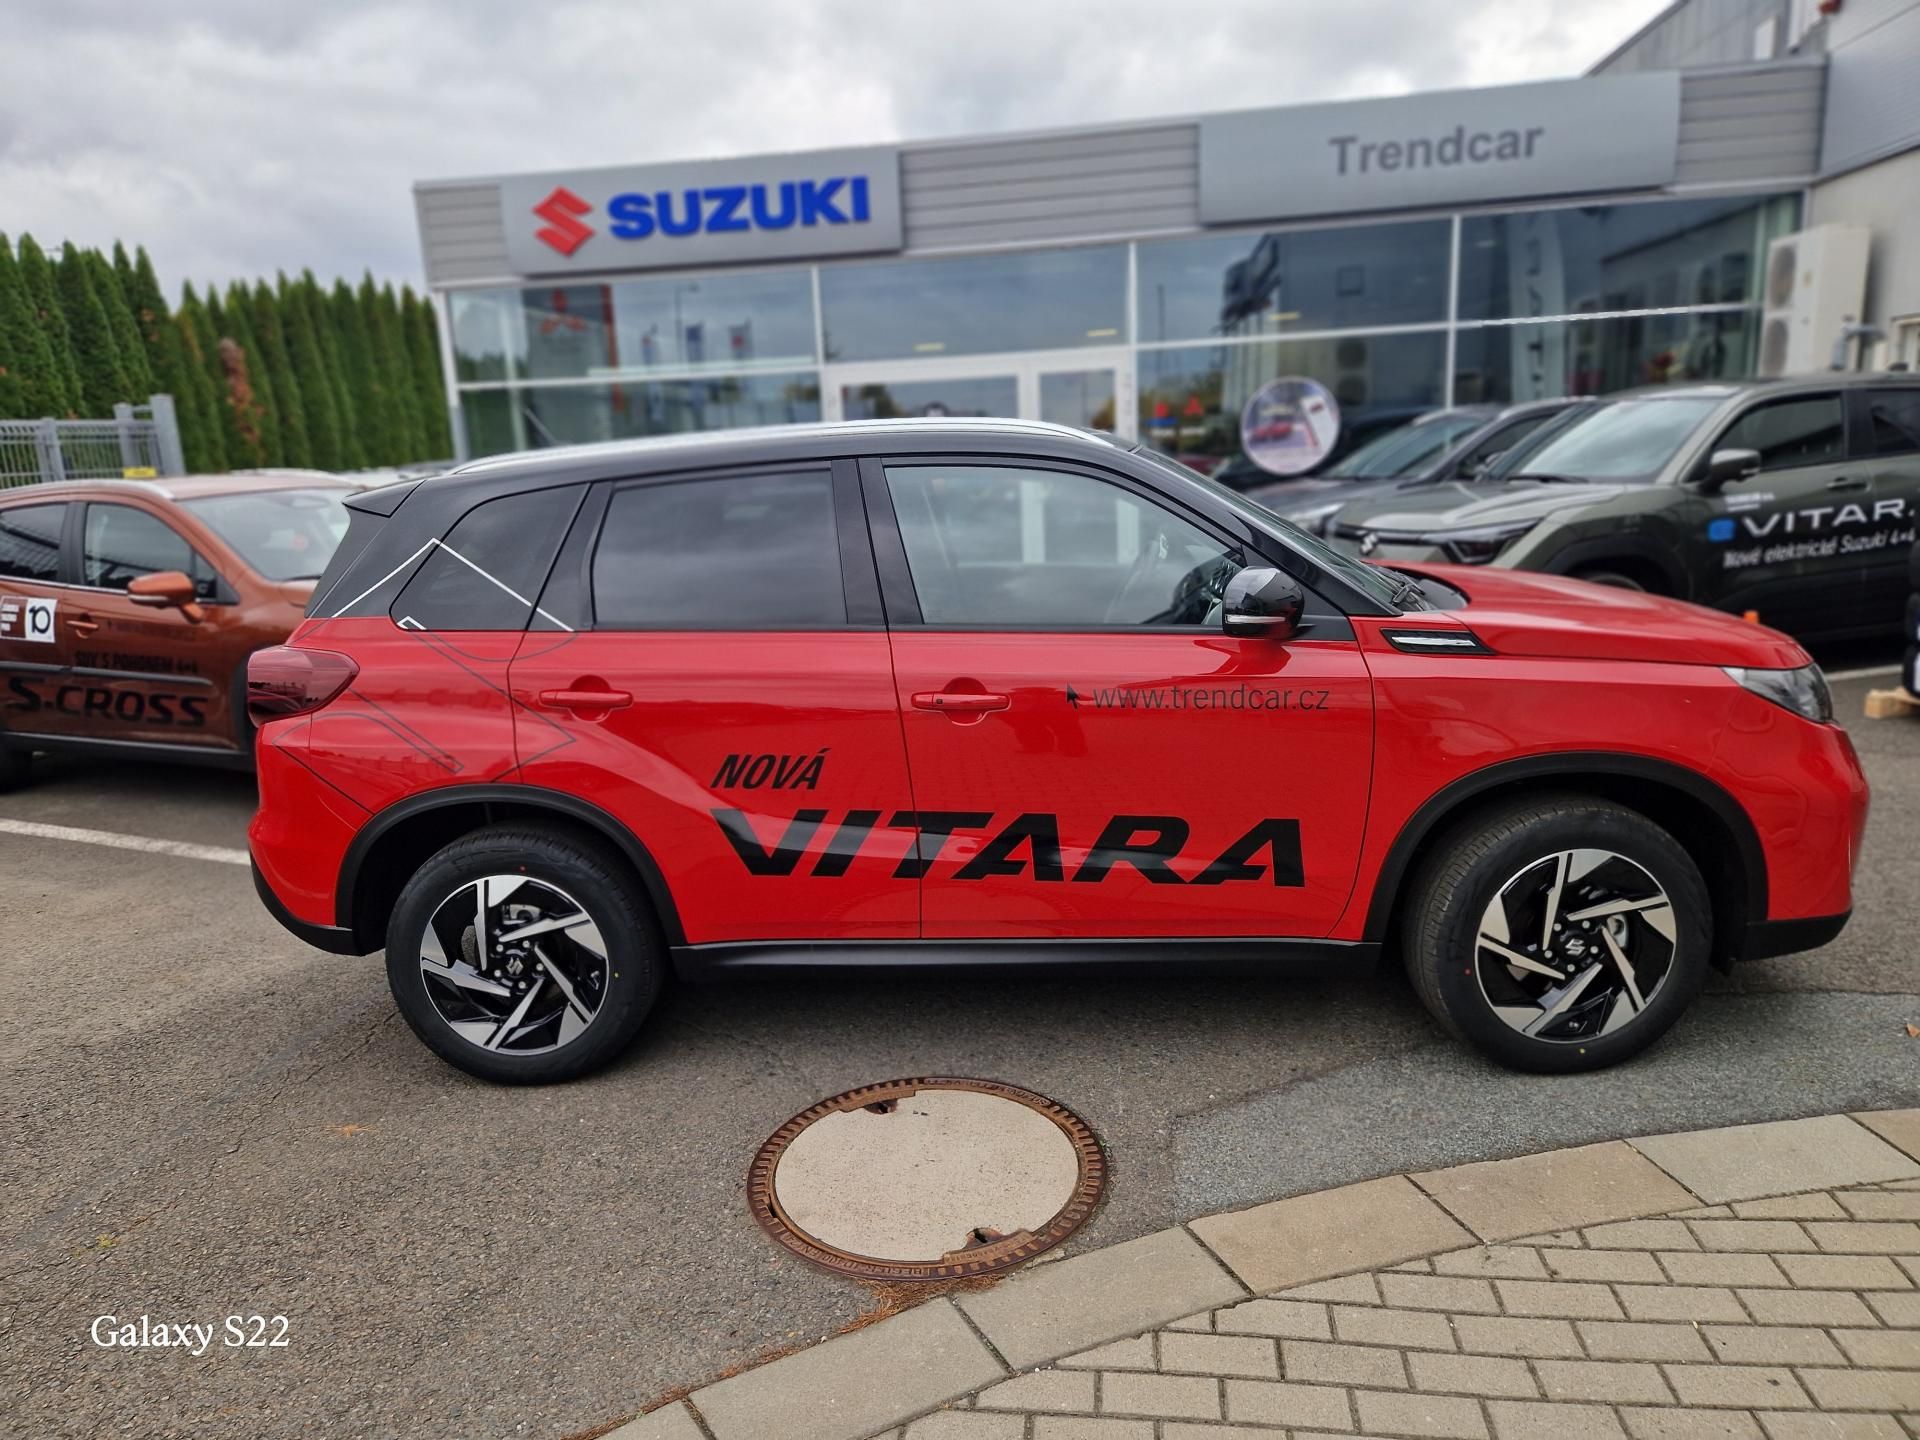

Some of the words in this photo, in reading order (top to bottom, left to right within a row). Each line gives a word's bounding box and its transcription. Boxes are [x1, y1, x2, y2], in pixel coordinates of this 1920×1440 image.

[1328, 124, 1545, 176] Trendcar
[606, 175, 872, 240] SUZUKI
[1742, 498, 1916, 537] VITAR
[1839, 529, 1889, 554] Suzuki
[1092, 683, 1330, 710] www.trendcar.cz
[710, 747, 832, 790] NOVÁ
[709, 808, 1306, 888] VITARA
